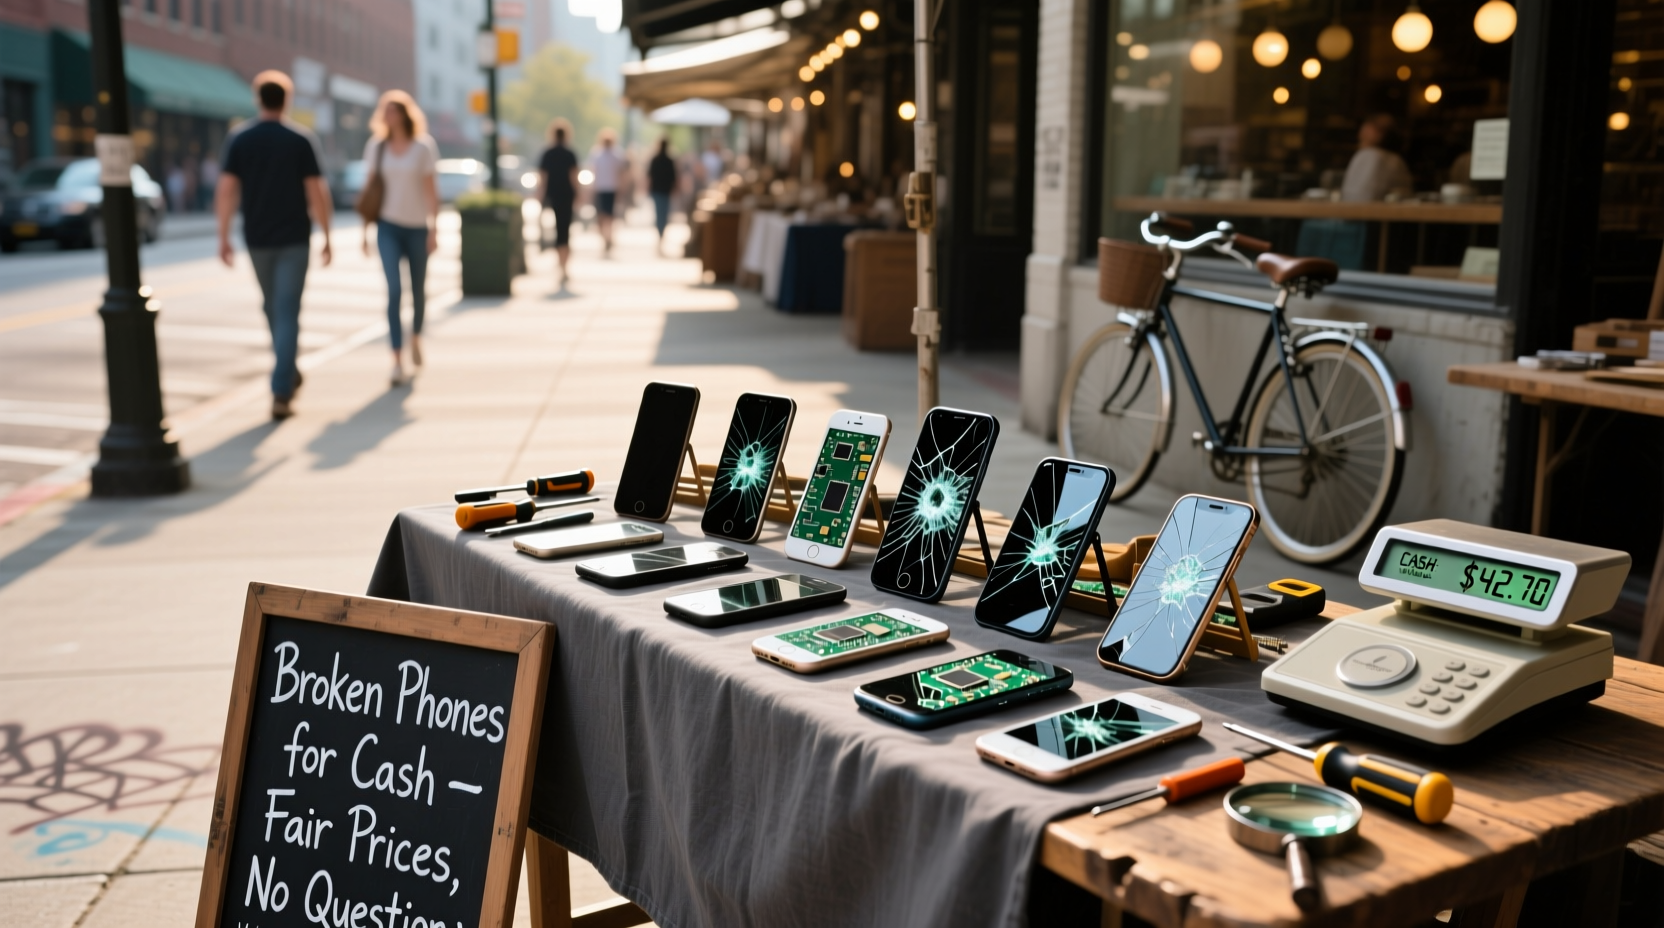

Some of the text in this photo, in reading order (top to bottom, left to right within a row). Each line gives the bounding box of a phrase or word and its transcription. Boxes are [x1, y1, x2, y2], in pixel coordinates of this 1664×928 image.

[1459, 560, 1551, 606] $42.70
[270, 641, 505, 743] Broken Phones
[283, 721, 337, 778] for
[351, 733, 435, 806] Cash
[244, 854, 290, 913] No
[264, 788, 460, 897] Fair Prices,
